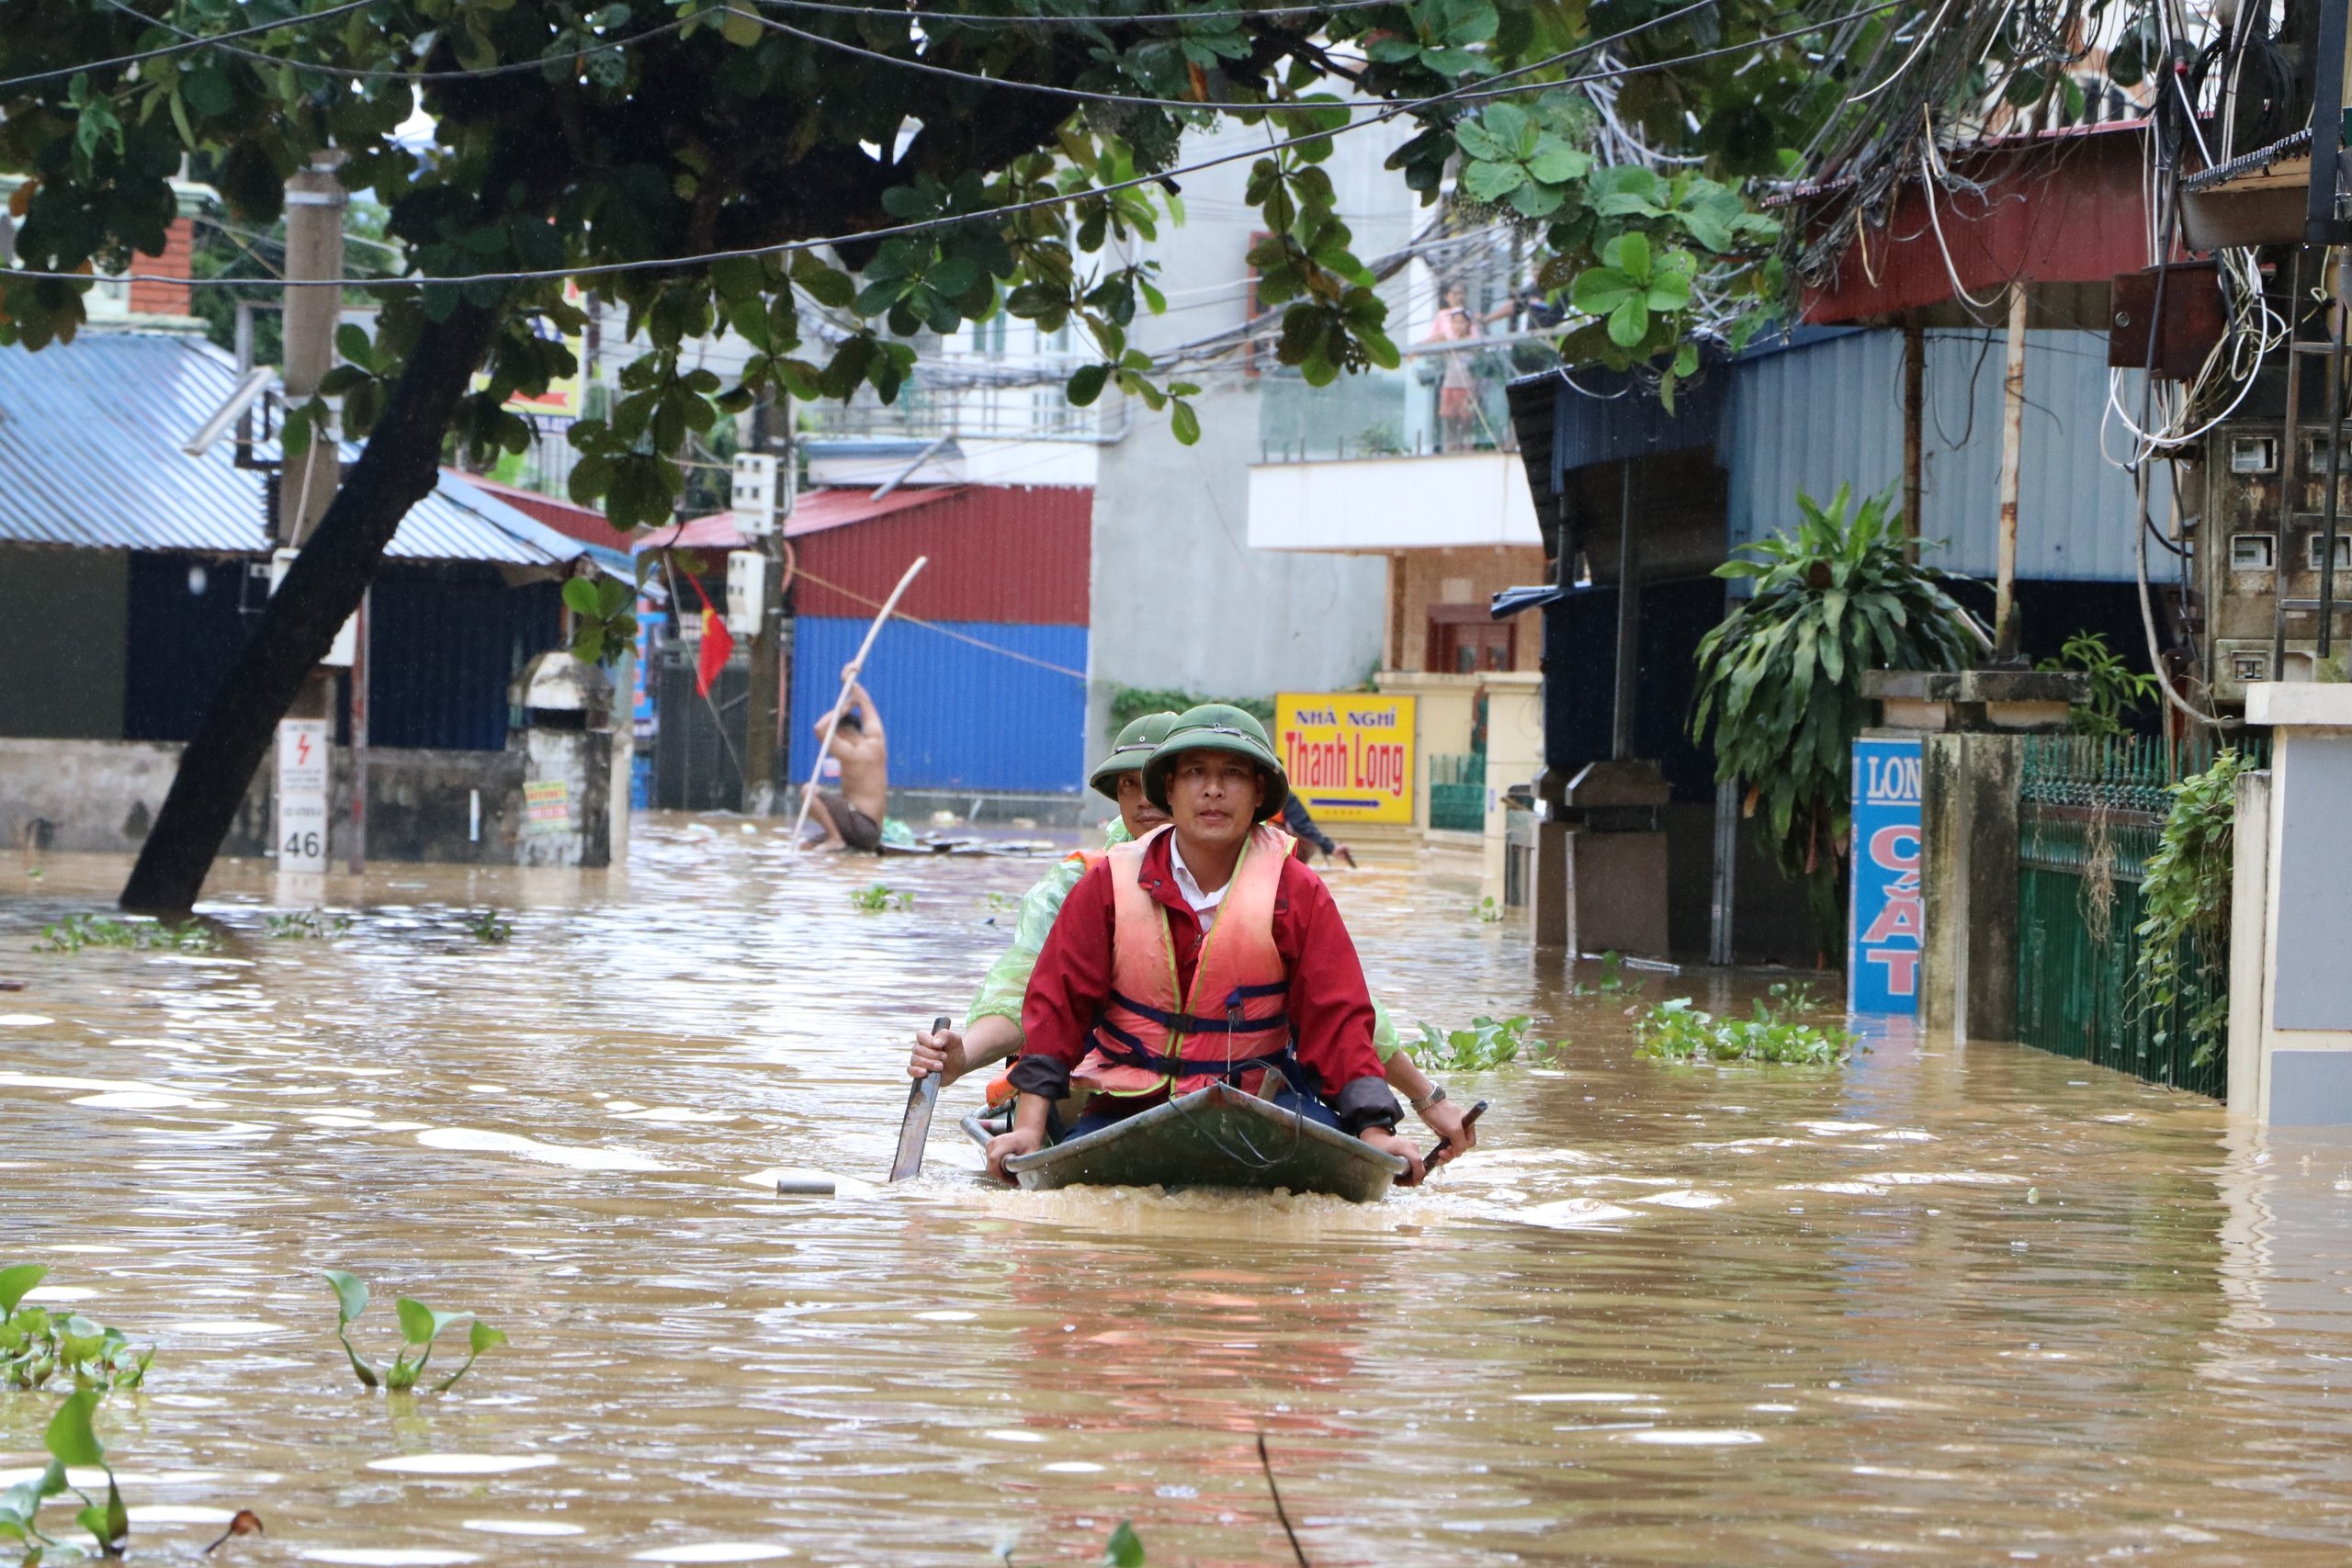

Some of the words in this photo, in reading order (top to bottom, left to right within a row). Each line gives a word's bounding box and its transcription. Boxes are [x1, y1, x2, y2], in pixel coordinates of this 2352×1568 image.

[1296, 705, 1337, 725] NHÀ
[1348, 705, 1396, 727] NGHỈ
[1285, 731, 1347, 787] Thanh
[1354, 732, 1404, 797] Long
[285, 831, 320, 859] 46
